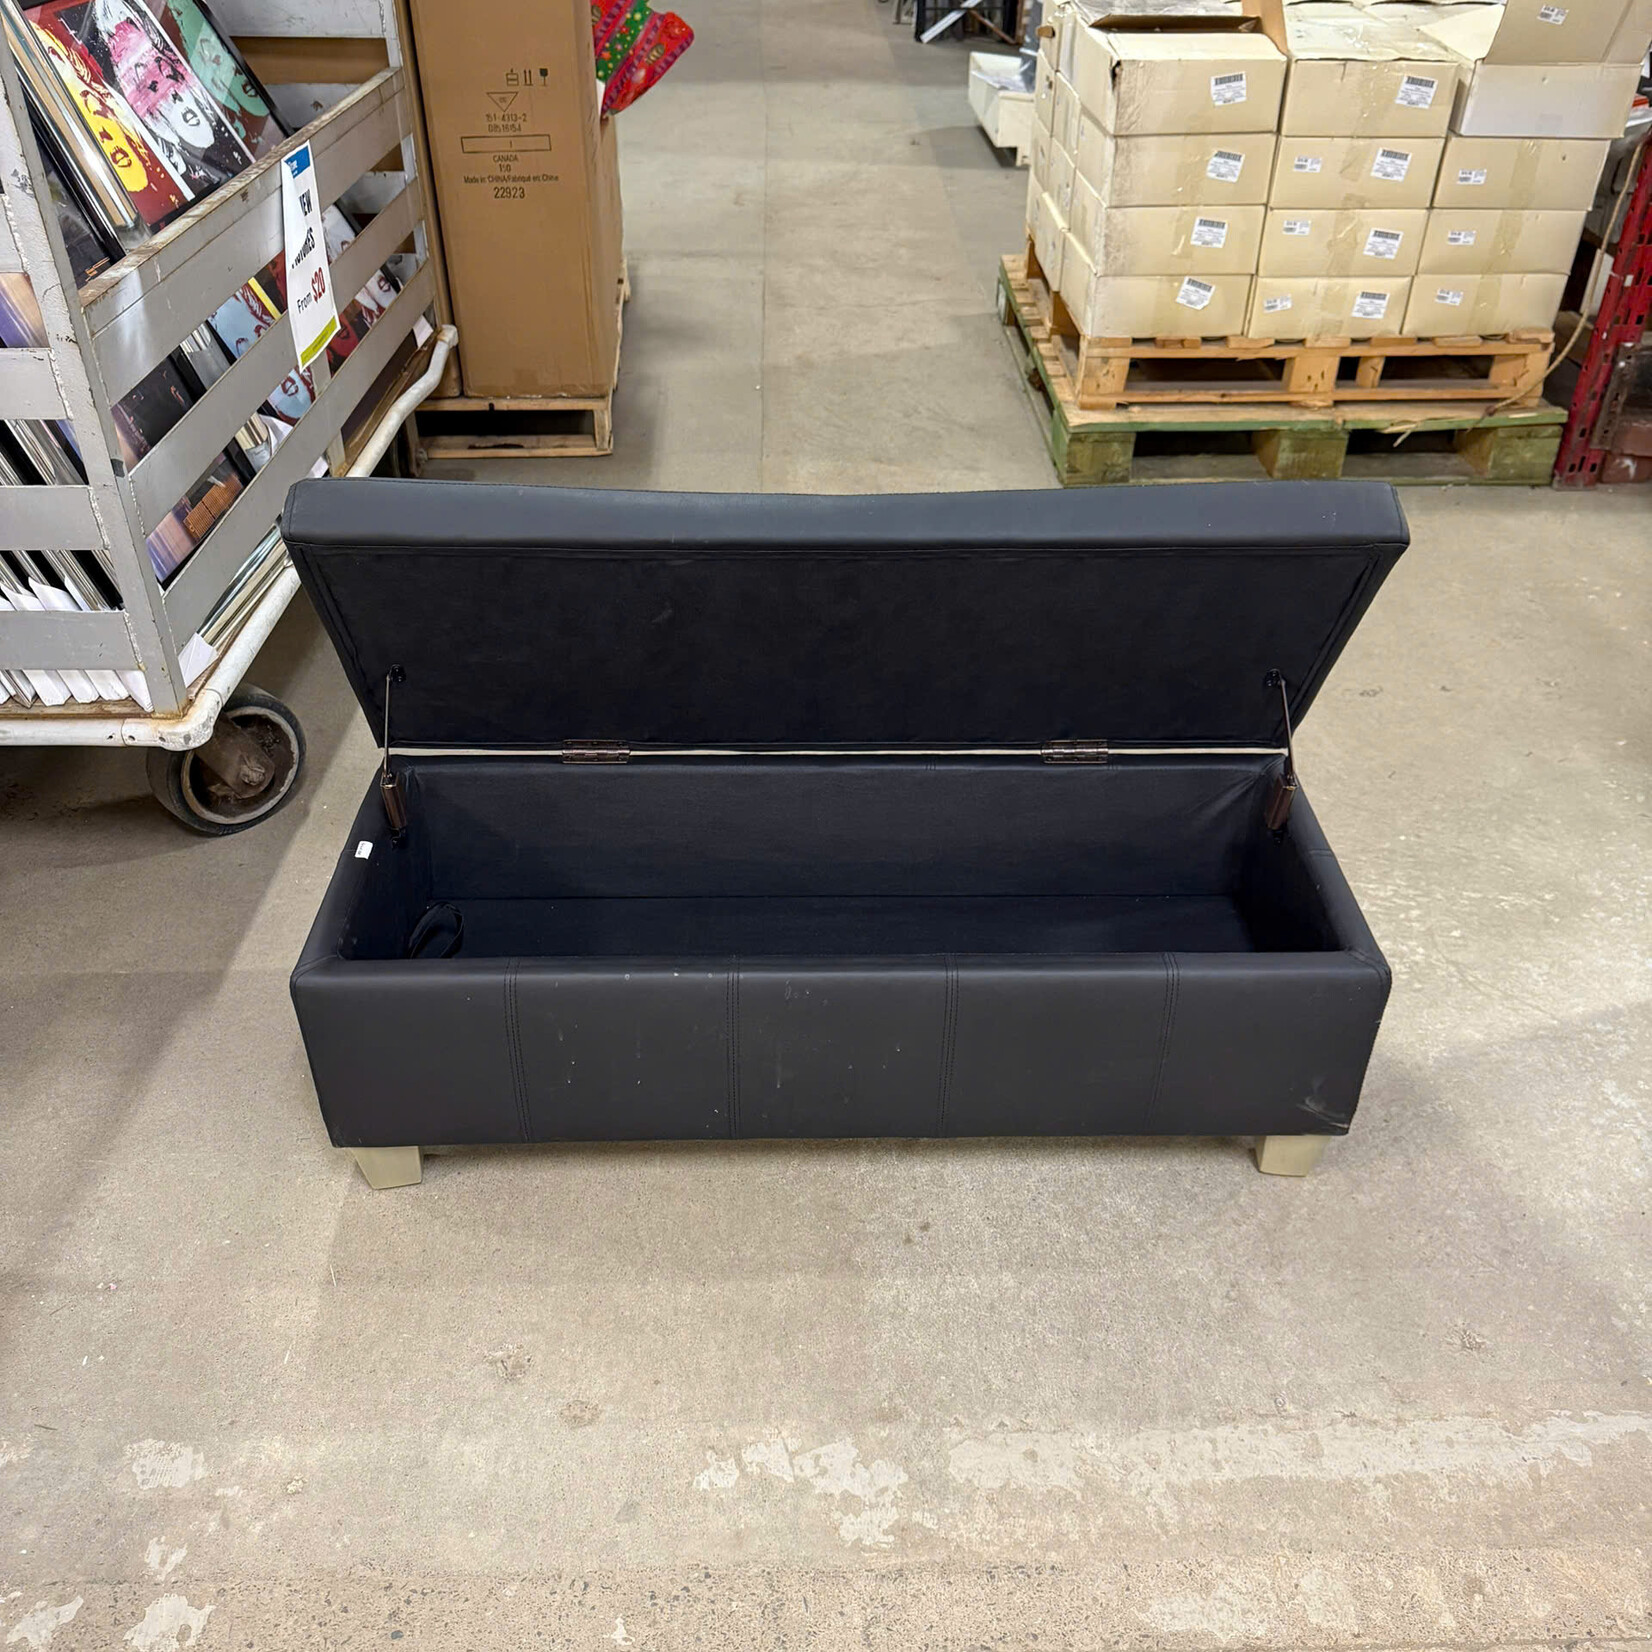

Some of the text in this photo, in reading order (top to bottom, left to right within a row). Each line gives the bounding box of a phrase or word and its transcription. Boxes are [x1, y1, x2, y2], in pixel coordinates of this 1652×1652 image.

[493, 154, 519, 163] CANADA
[464, 176, 480, 184] Made
[493, 187, 525, 199] 22923
[296, 266, 326, 314] From $20
